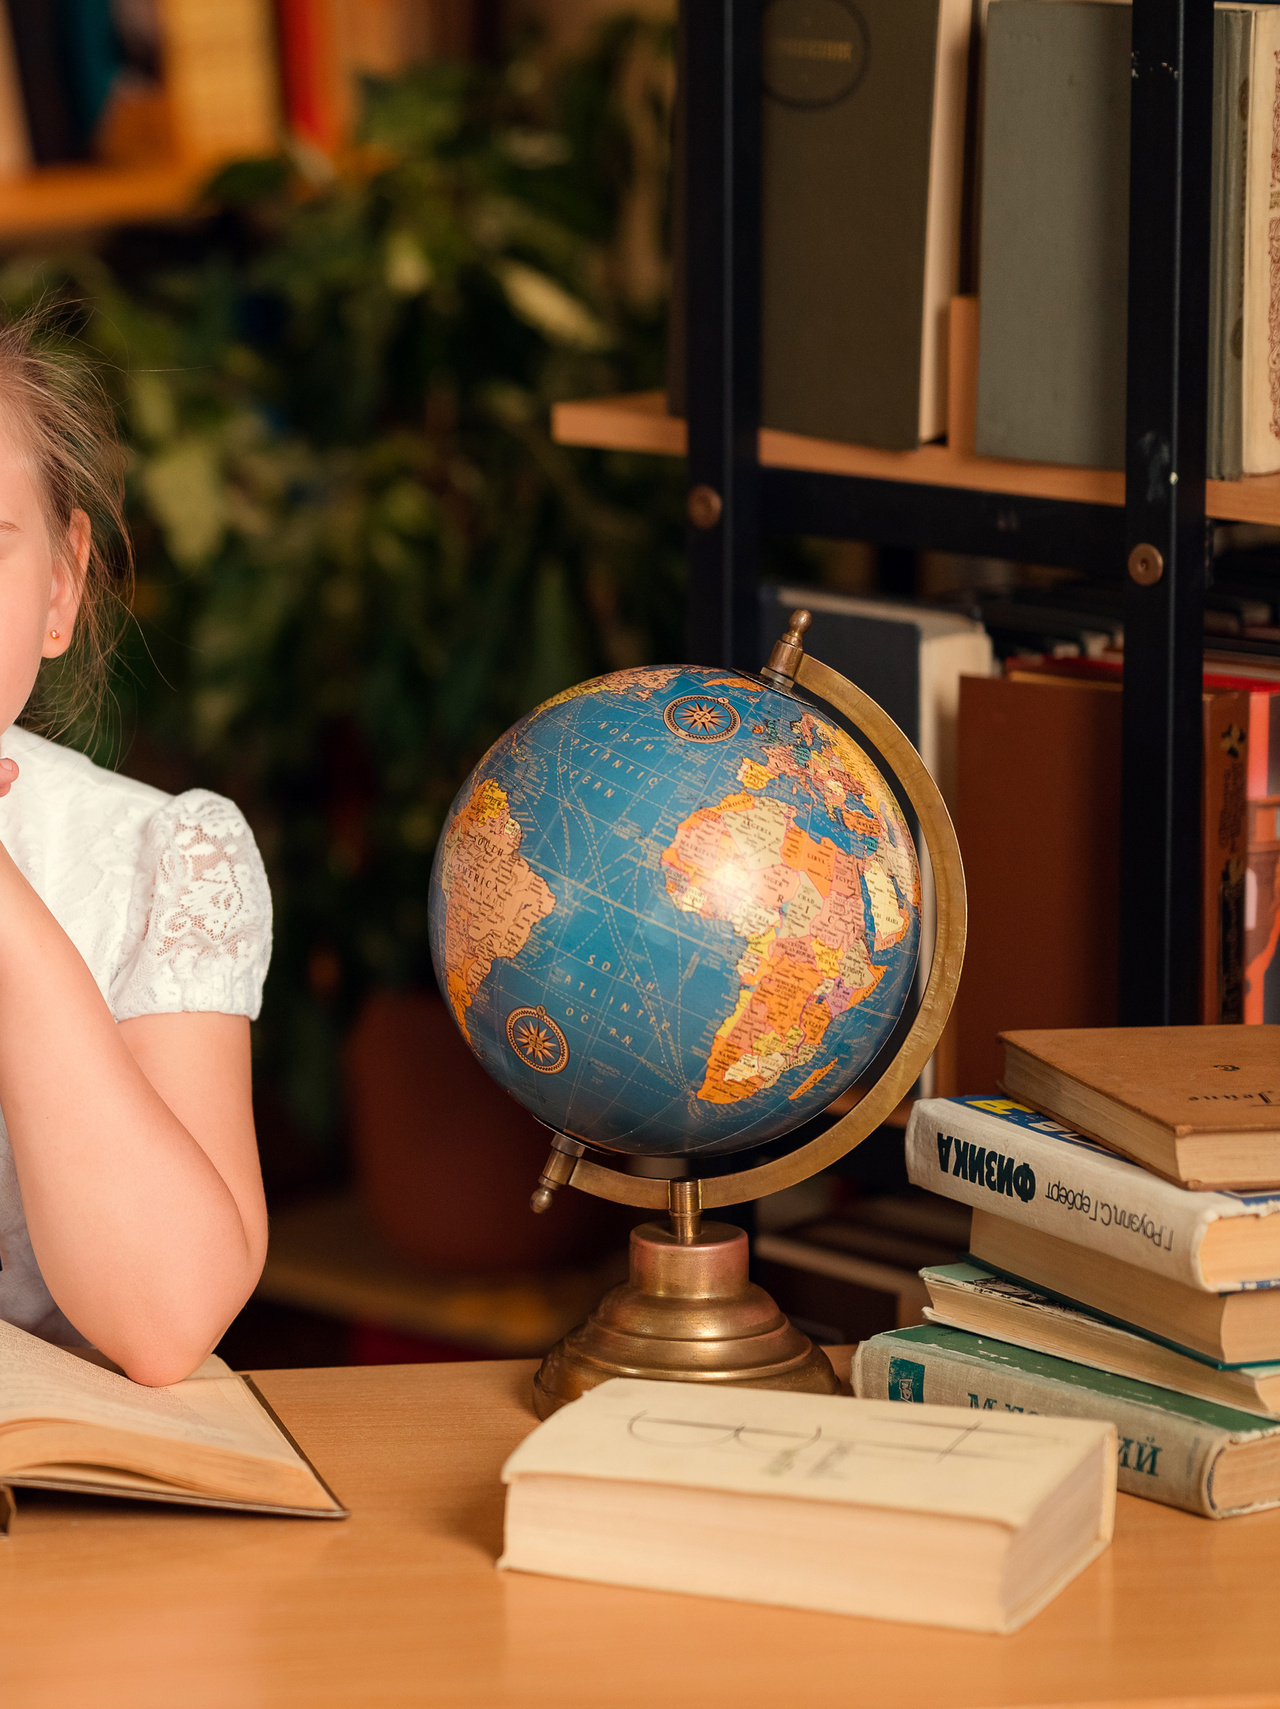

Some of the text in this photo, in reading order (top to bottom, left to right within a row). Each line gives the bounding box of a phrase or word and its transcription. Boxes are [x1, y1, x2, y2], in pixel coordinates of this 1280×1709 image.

[598, 721, 655, 752] NORTH
[559, 764, 616, 798] OCEAN
[571, 738, 660, 787] ATLANTIC
[565, 1007, 634, 1045] OCAN
[937, 1131, 1036, 1203] ФИЗИКА
